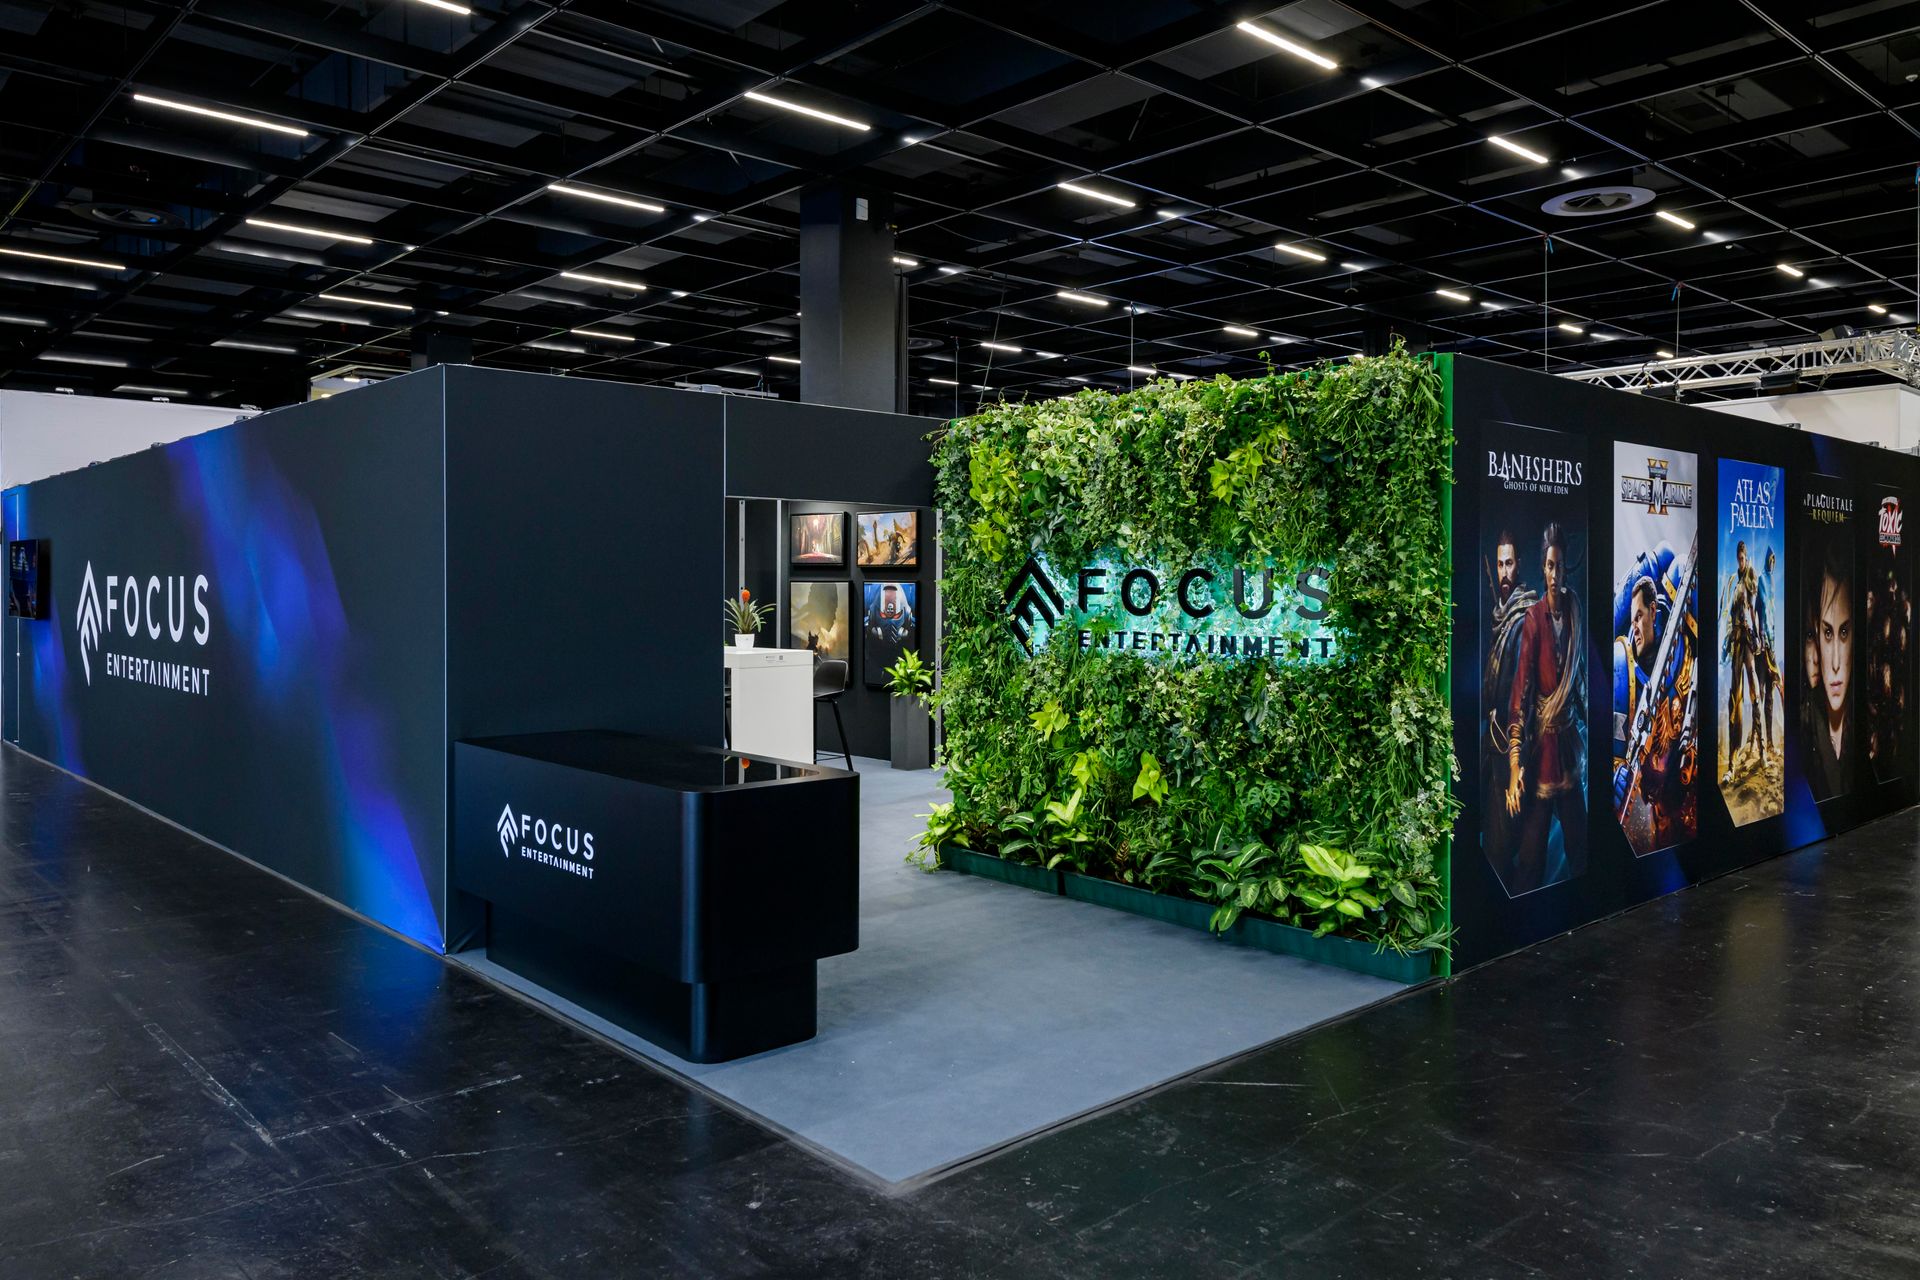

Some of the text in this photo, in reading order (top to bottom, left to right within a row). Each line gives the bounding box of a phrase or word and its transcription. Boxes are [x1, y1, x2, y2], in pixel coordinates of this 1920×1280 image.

[1487, 451, 1583, 486] BANISHERS
[1503, 480, 1569, 496] GHOSTS OF NEW EDEN
[1621, 478, 1693, 514] SPACE MARINE
[1734, 479, 1771, 505] ATLAS
[1730, 502, 1775, 534] FALLEN
[1812, 509, 1844, 524] REQUIEM
[1879, 507, 1903, 533] TOXIC
[106, 574, 210, 646] FOCUS
[1078, 567, 1331, 621] FOCUS
[106, 652, 210, 696] ENTERTAINMENT
[521, 813, 594, 860] FOCUS
[521, 846, 594, 880] ENTERTAINMENT
